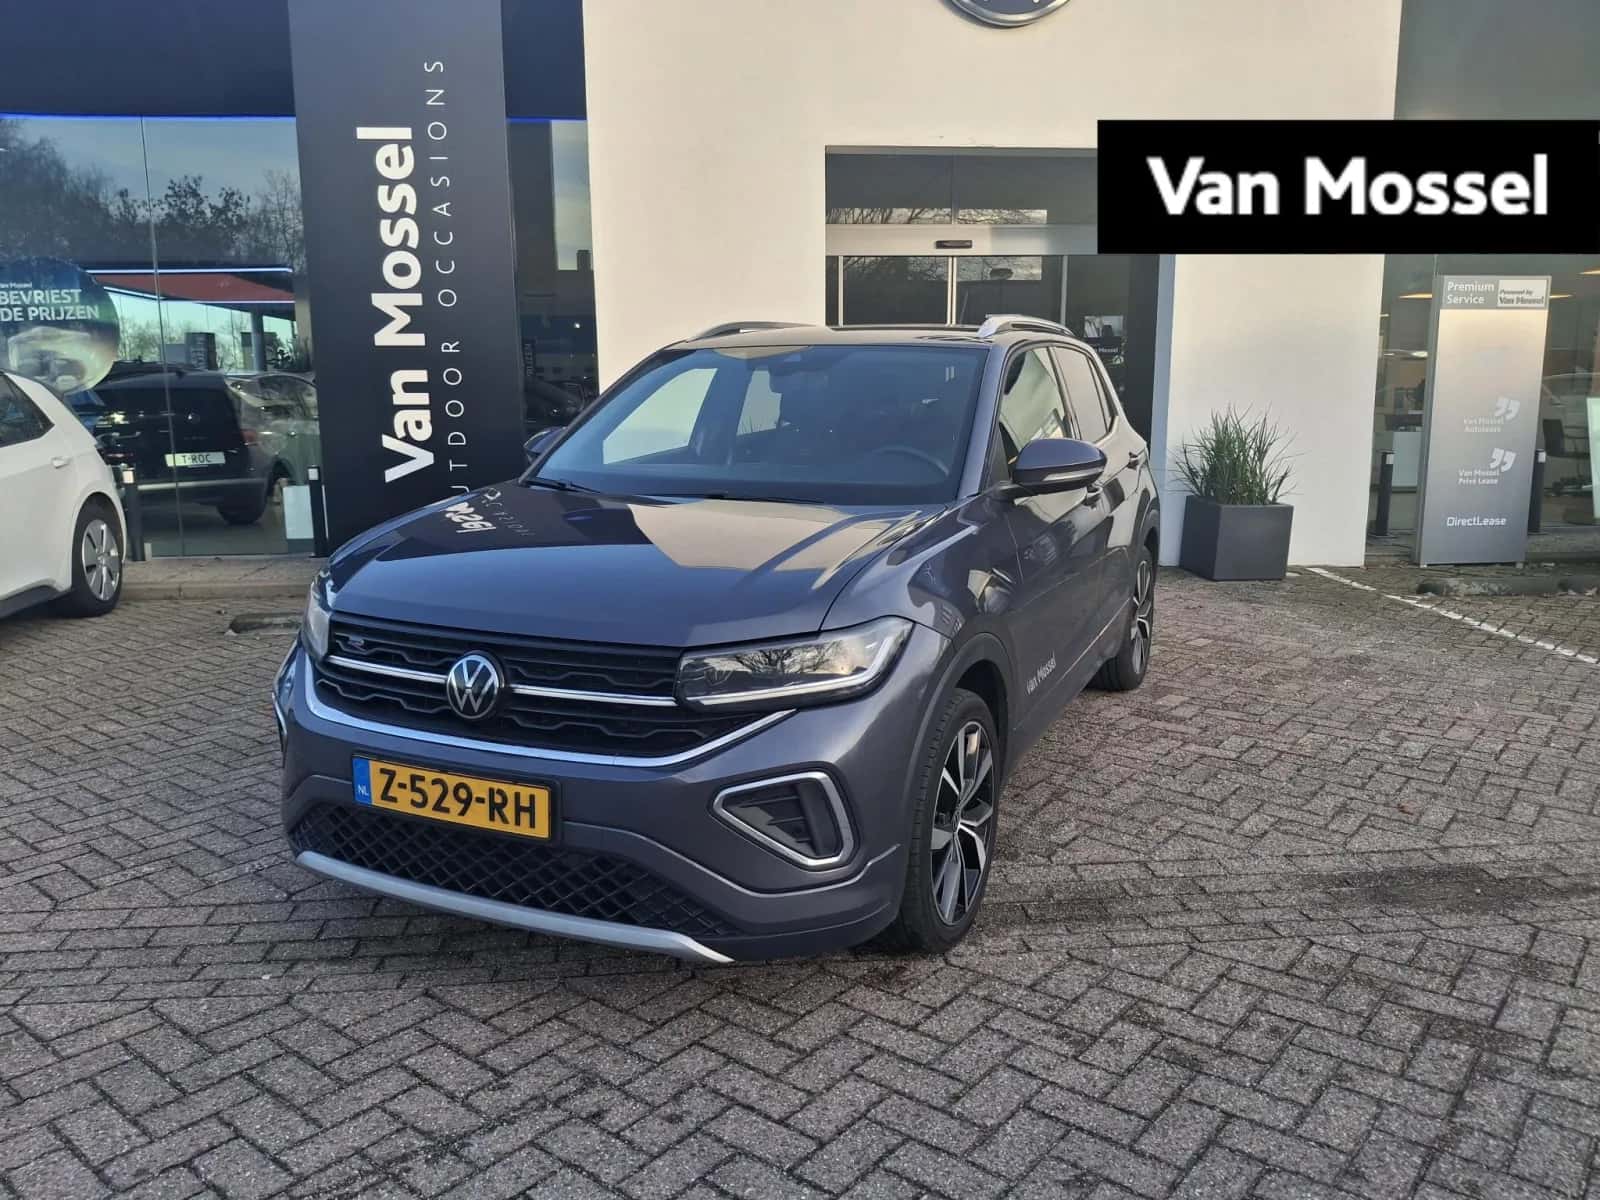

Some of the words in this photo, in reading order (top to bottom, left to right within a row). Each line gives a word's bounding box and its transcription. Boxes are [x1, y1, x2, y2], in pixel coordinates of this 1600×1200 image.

[424, 61, 457, 307] OCCASIONS
[356, 126, 426, 347] Mossel
[1447, 281, 1495, 292] Premium
[0, 288, 82, 305] BEVRIEST
[1447, 293, 1485, 304] Service
[0, 307, 24, 321] DE
[28, 304, 100, 321] PRIJZEN
[441, 340, 470, 493] TDOOR
[381, 369, 435, 483] Van
[182, 454, 211, 465] T-ROC
[1446, 515, 1507, 527] DirectLease
[357, 784, 370, 796] NL
[379, 767, 536, 829] Z-529-RH
